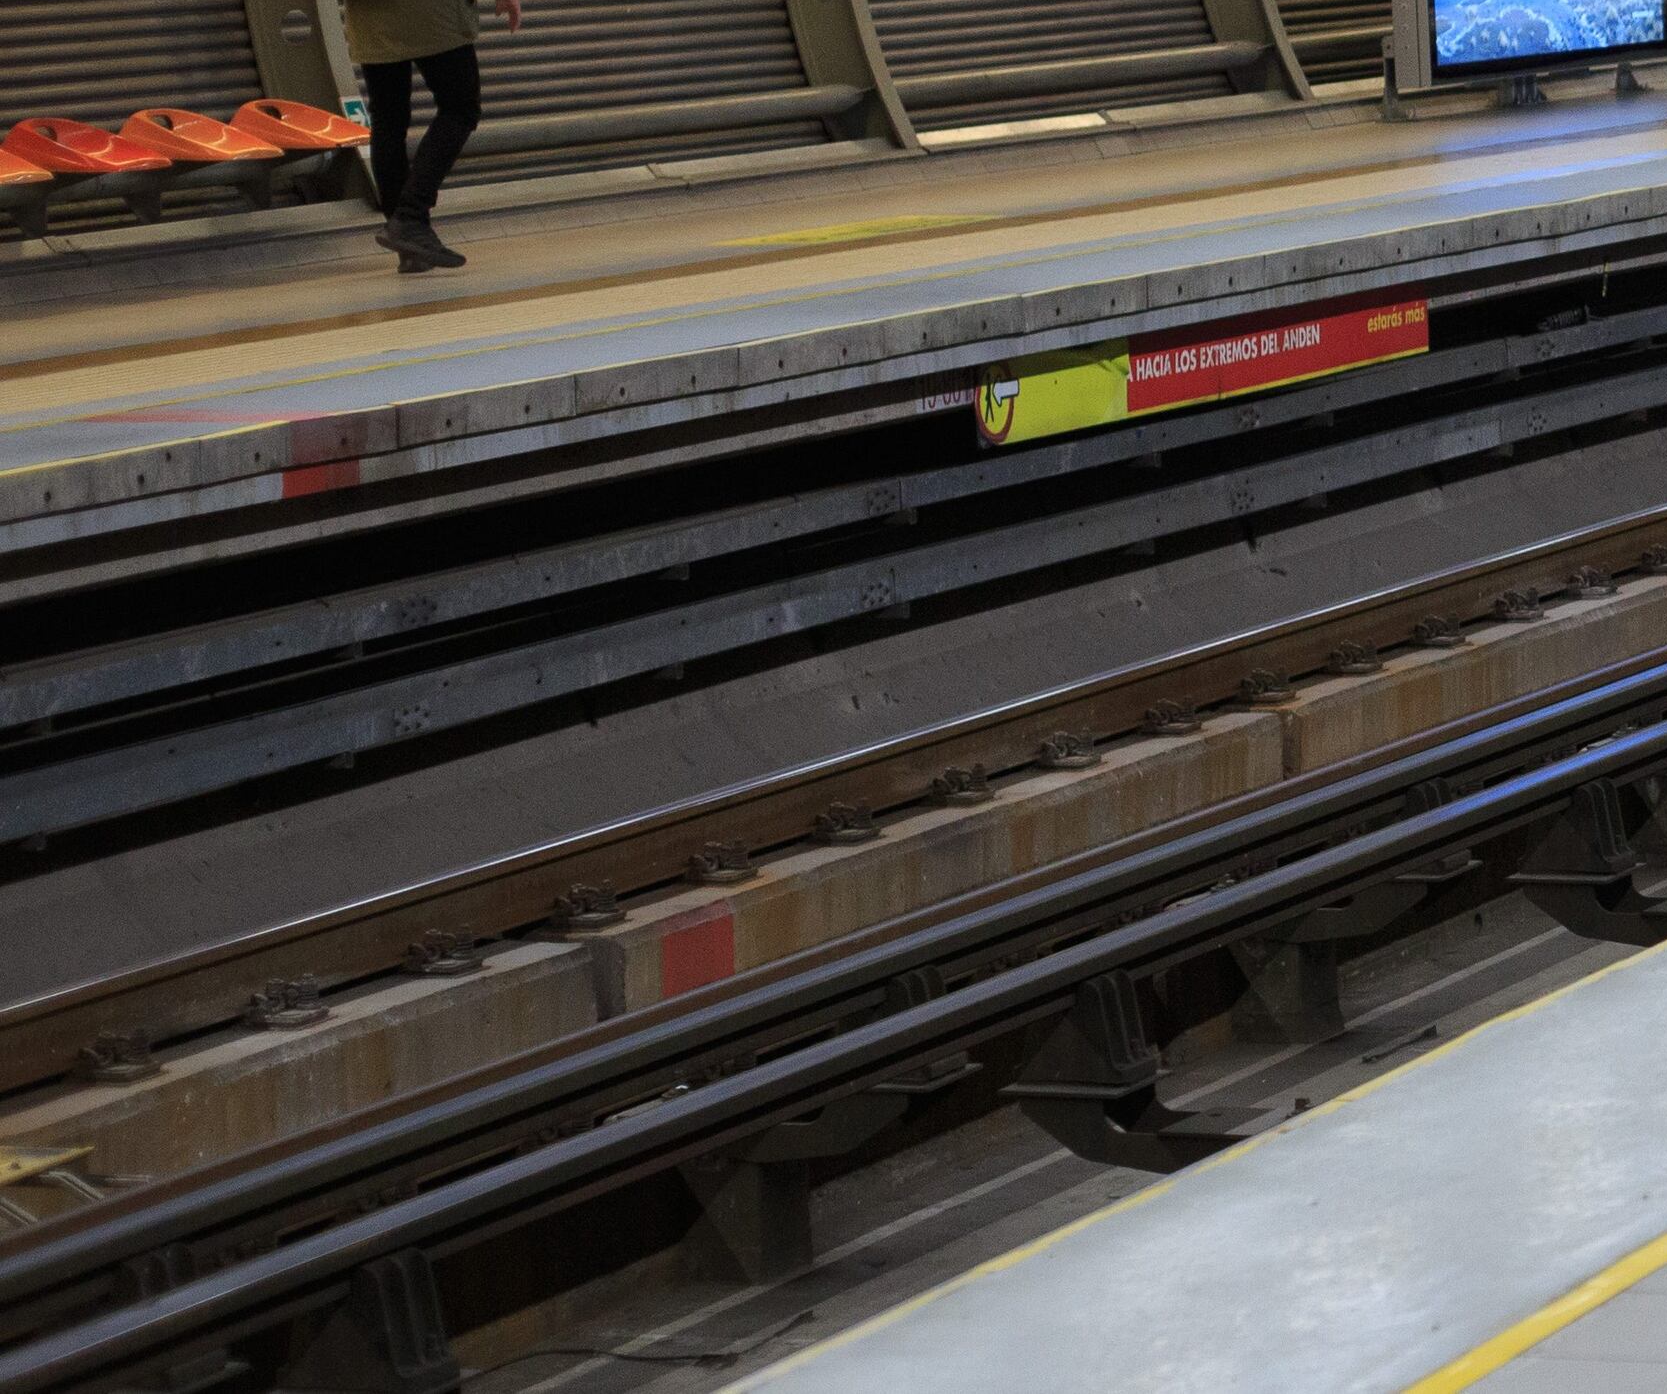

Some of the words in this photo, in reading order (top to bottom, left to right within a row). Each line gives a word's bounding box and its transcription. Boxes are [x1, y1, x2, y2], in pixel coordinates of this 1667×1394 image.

[1367, 304, 1402, 333] estarás
[1405, 301, 1426, 324] más
[1136, 353, 1172, 381] HACIA
[1175, 349, 1197, 374] LOS
[1200, 337, 1257, 367] EXTREMOS
[1261, 331, 1280, 353] DEL
[1283, 324, 1321, 351] ANDEN
